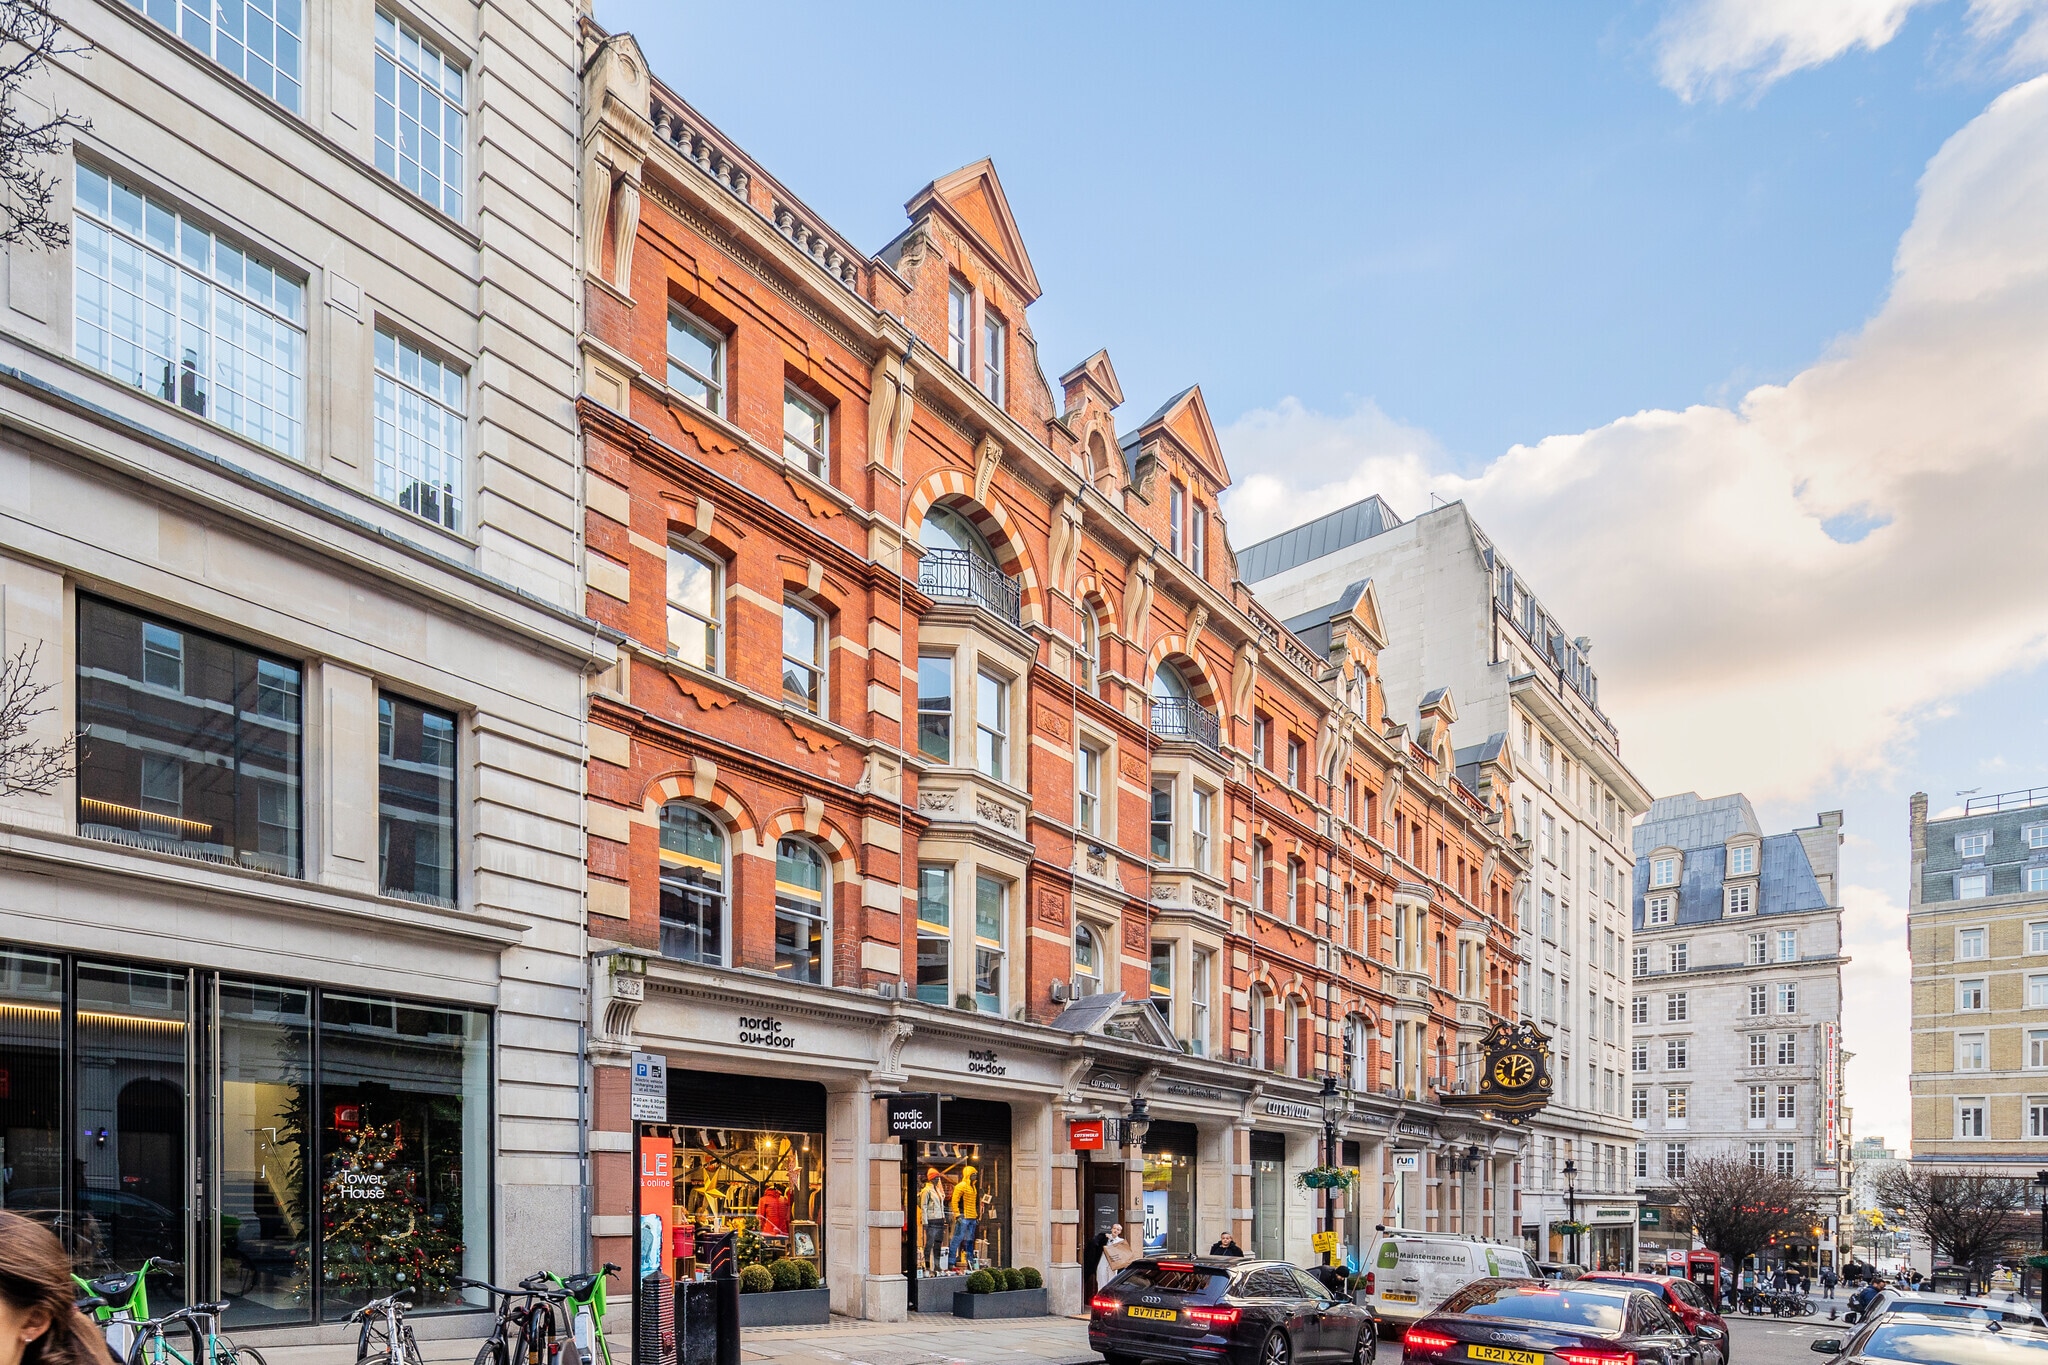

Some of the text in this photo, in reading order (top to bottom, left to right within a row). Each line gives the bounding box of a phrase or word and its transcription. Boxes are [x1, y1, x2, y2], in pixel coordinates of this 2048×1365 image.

[740, 1016, 782, 1032] nordic
[740, 1032, 795, 1048] outdoor
[969, 1050, 998, 1063] nordic
[968, 1062, 1006, 1075] outdoor
[1090, 1080, 1120, 1090] COTSWOLD
[893, 1110, 923, 1119] nordic
[1267, 1102, 1311, 1118] COTSWOLD
[893, 1120, 932, 1130] outdoor
[1400, 1122, 1430, 1136] COTSWOLD
[1397, 1156, 1414, 1164] run
[340, 1170, 384, 1184] Tower
[340, 1185, 385, 1199] House
[1143, 1218, 1159, 1239] ALE
[1400, 1252, 1450, 1261] Maintenance
[1452, 1254, 1466, 1262] Ltd
[1134, 1307, 1171, 1318] BV71 EAP
[1476, 1348, 1534, 1364] LR21 XZN
